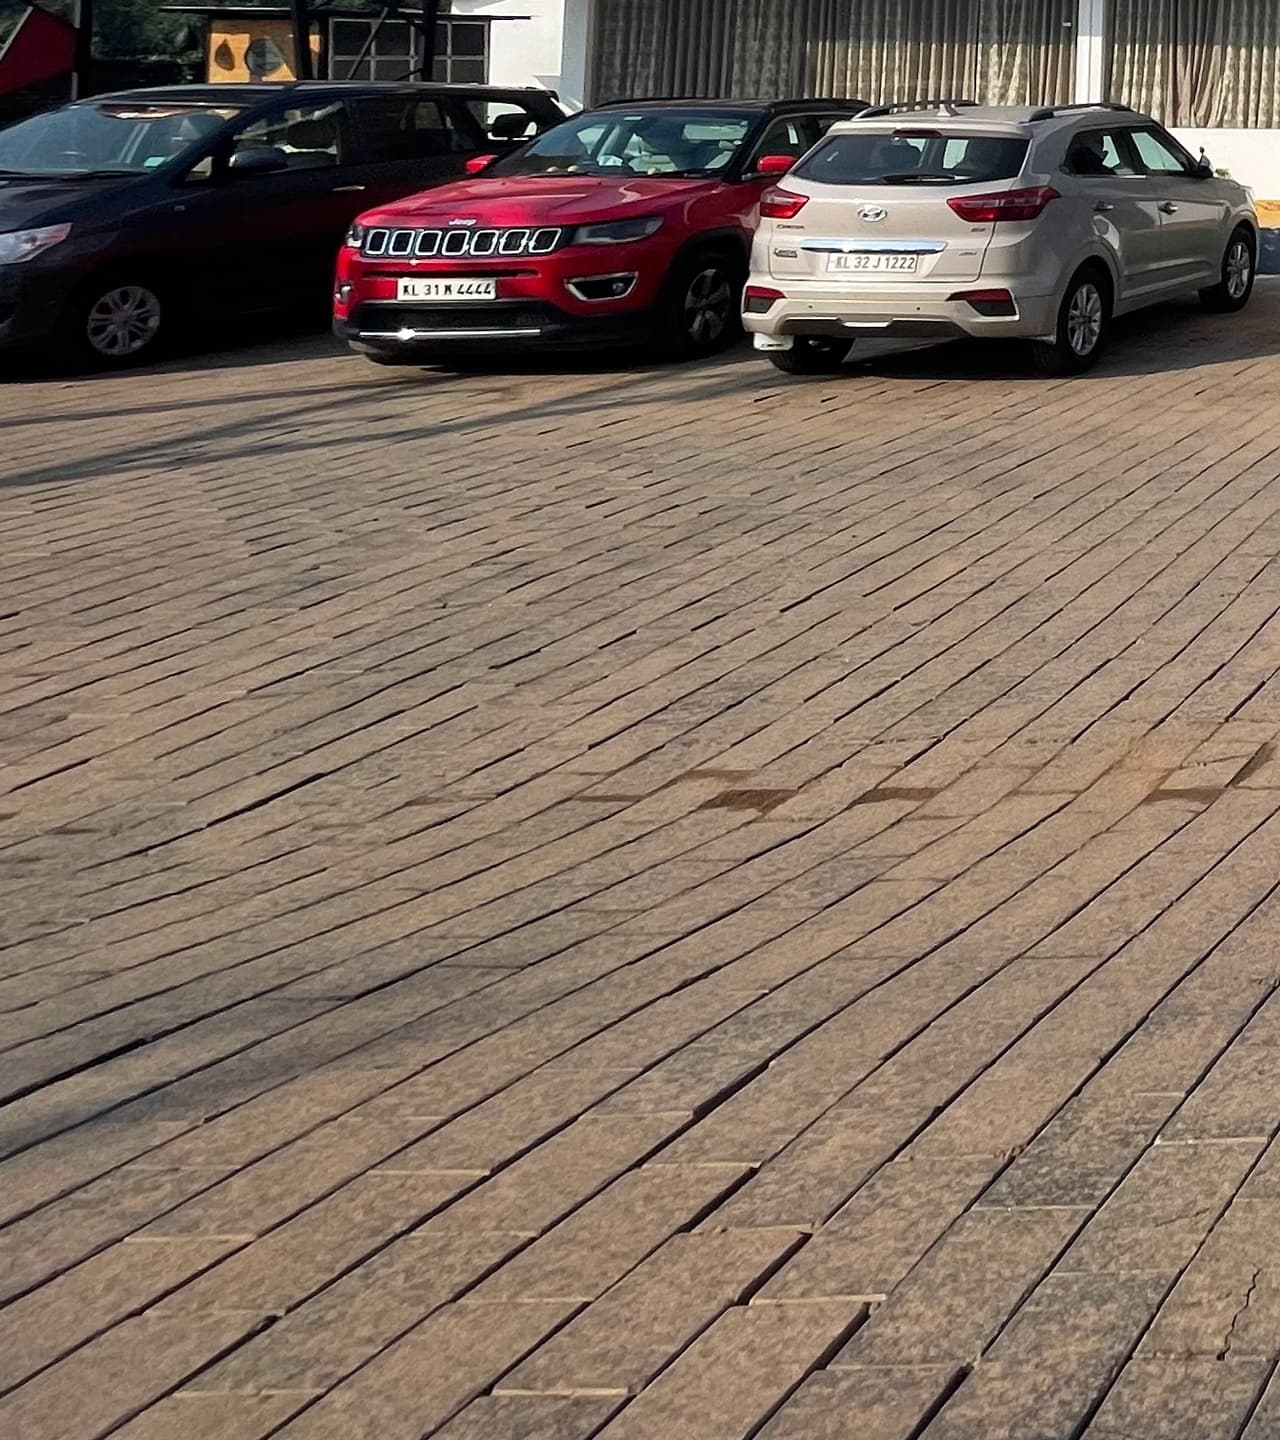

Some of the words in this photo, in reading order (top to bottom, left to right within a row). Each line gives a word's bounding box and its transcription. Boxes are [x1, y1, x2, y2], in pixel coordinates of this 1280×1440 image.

[836, 256, 850, 268] KL
[854, 256, 870, 268] 32
[872, 256, 881, 269] J
[885, 257, 915, 269] 1222
[403, 284, 418, 296] KL
[424, 284, 439, 295] 31
[457, 283, 491, 295] 4444
